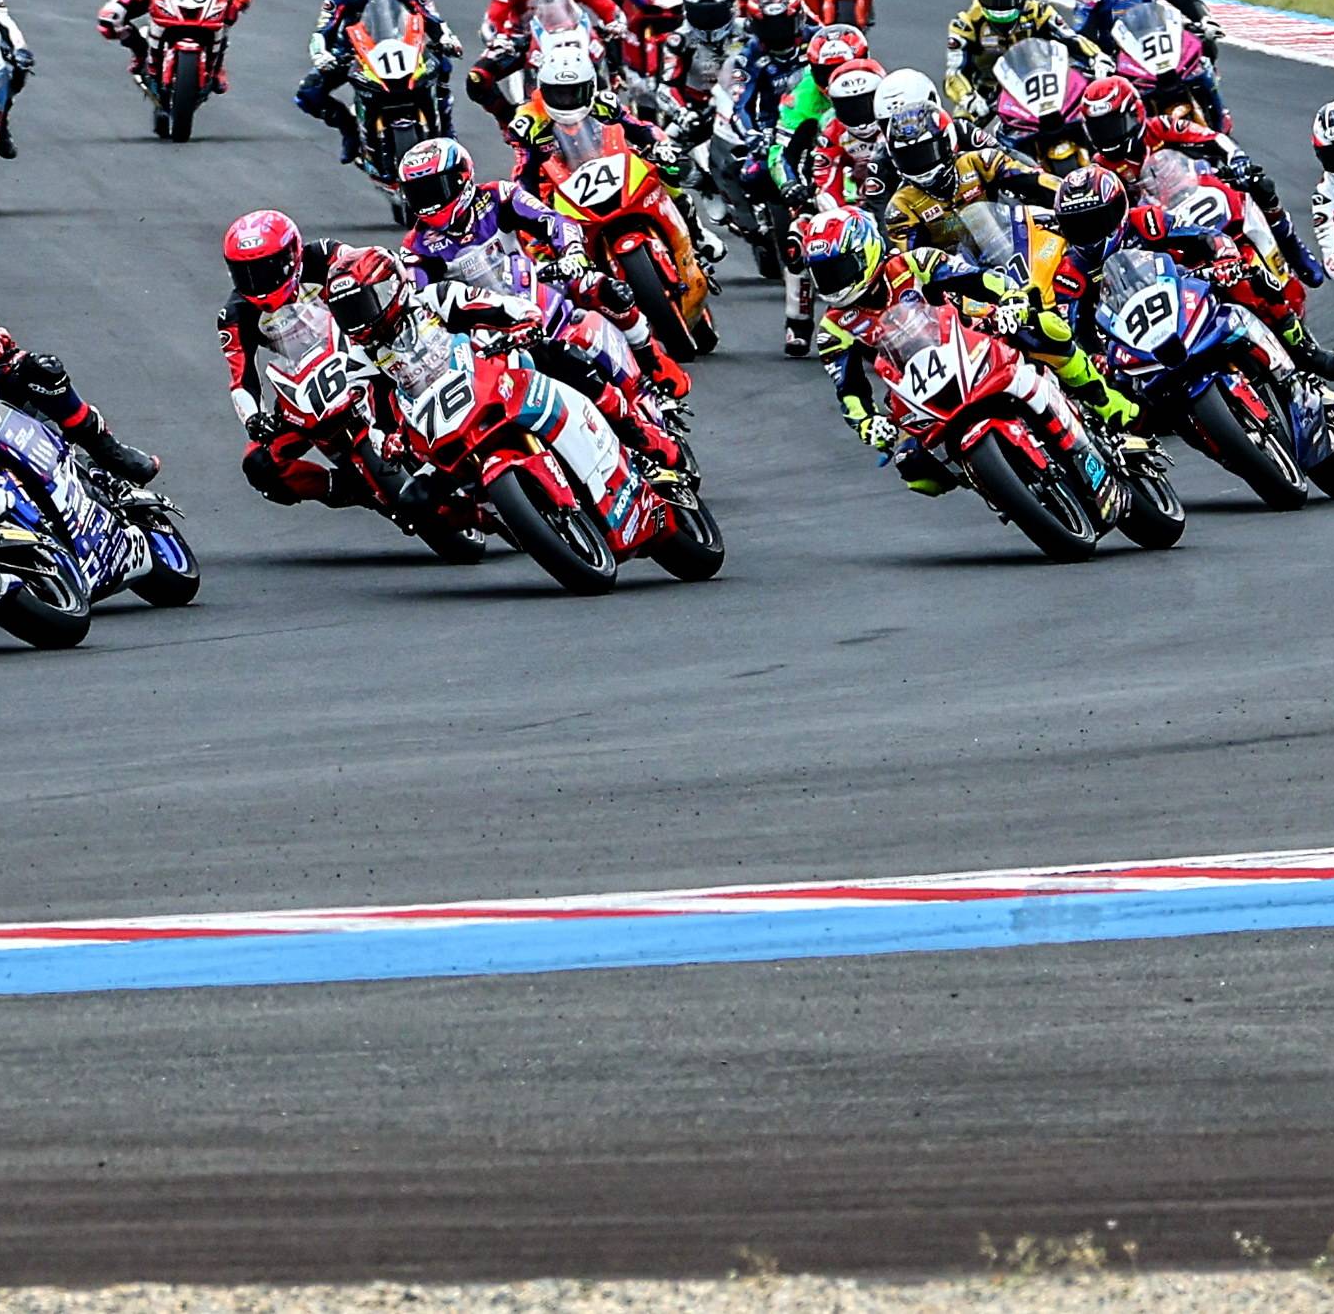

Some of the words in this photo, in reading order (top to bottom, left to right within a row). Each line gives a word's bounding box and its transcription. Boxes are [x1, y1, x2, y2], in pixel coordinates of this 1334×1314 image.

[378, 50, 406, 75] 11
[1143, 34, 1173, 62] 50
[1024, 73, 1059, 104] 98
[574, 164, 620, 205] 24
[1125, 290, 1173, 347] 99
[303, 357, 347, 417] 16
[909, 349, 947, 397] 44
[132, 534, 145, 570] 39
